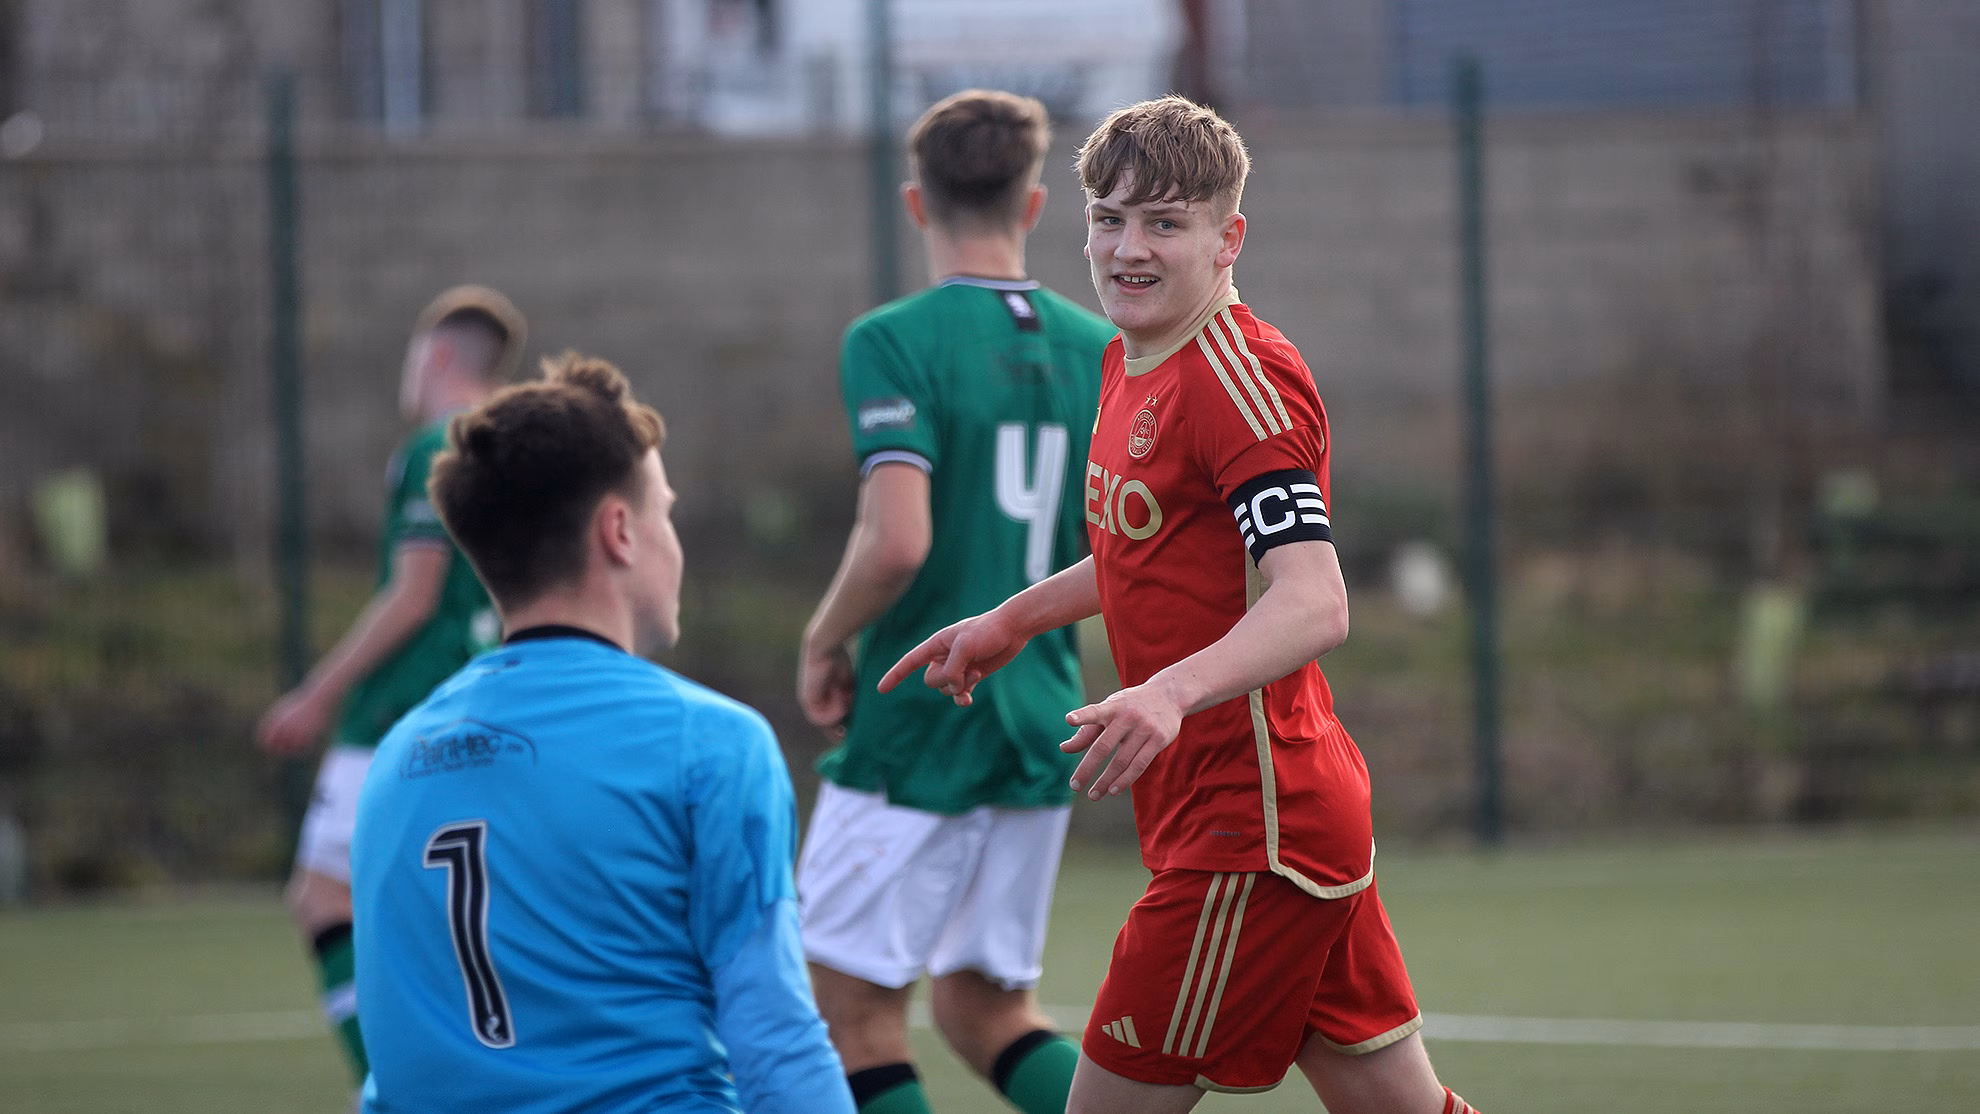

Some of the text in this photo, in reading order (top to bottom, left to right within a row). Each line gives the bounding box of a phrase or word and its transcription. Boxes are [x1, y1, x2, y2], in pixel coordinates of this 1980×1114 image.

[995, 421, 1069, 586] 4
[1087, 460, 1163, 540] EXO
[1251, 487, 1296, 536] C
[422, 819, 516, 1049] 1
